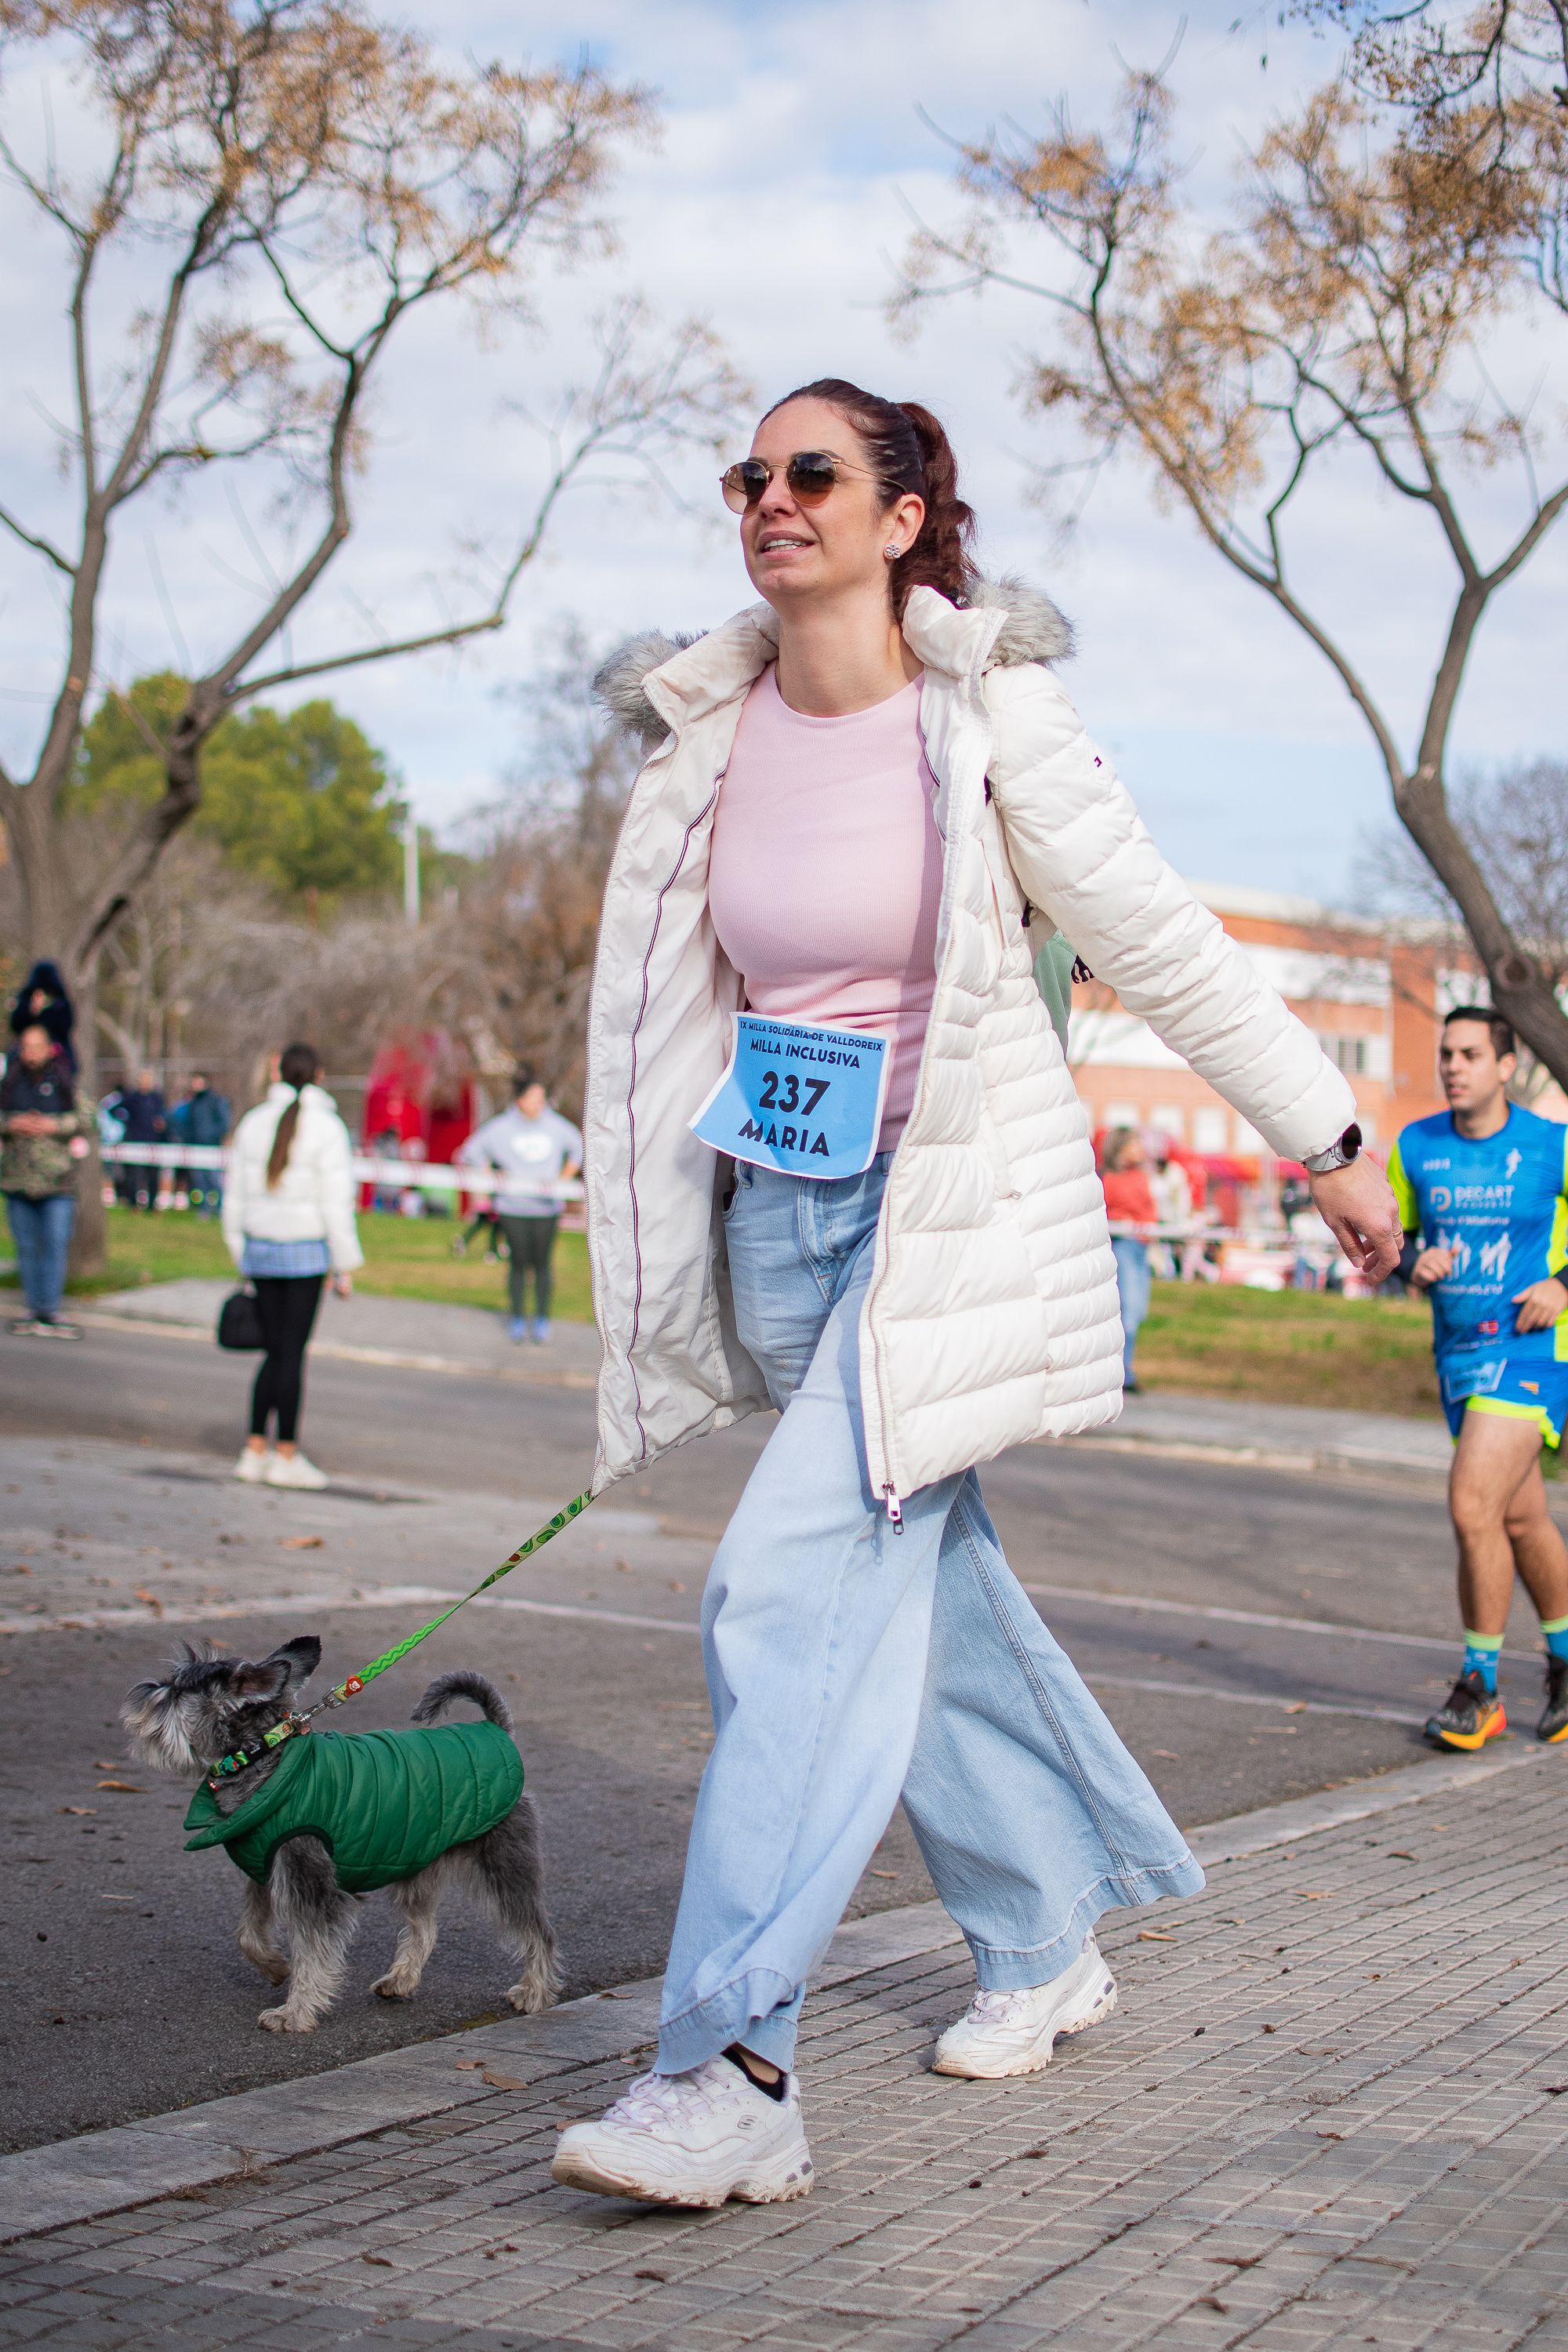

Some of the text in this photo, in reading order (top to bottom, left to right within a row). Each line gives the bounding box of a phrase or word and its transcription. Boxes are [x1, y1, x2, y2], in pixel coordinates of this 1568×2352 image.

[740, 1021, 747, 1029] IX
[749, 1022, 767, 1033] MILLA
[811, 1032, 825, 1042] DE
[826, 1034, 883, 1051] VALLDOREIX
[750, 1038, 860, 1069] MILLA INCLUSIVA
[758, 1071, 831, 1116] 237
[737, 1118, 830, 1156] MARIA
